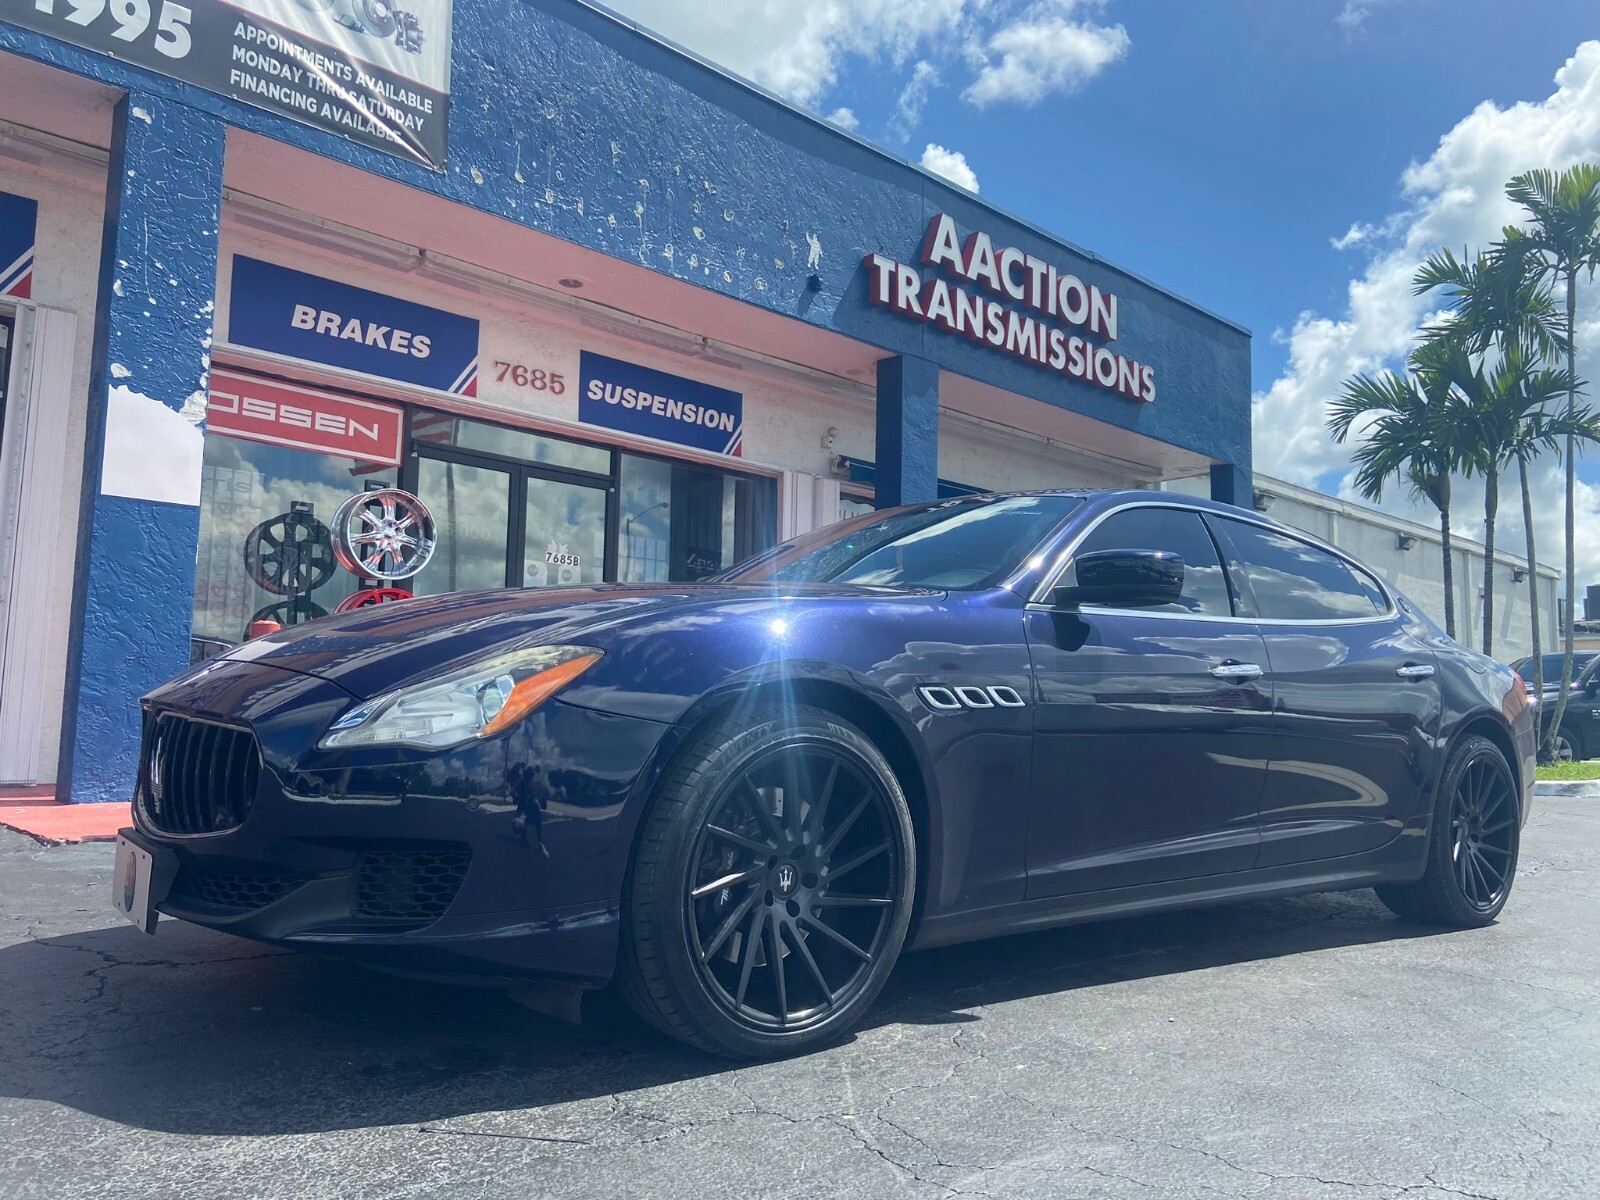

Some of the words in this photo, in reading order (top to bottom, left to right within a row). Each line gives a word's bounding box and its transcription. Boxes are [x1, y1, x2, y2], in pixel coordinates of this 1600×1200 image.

[35, 0, 192, 59] 95
[232, 45, 304, 83] MONDAY
[306, 72, 347, 100] THRU
[349, 91, 425, 132] SATURDAY
[234, 22, 352, 81] APPOINTMENTS
[356, 73, 433, 114] AVAILABLE
[230, 69, 318, 113] FINANCING
[320, 105, 402, 143] AVAILABLE
[922, 212, 1118, 343] AACTION
[291, 303, 432, 360] BRAKES
[865, 253, 1156, 403] TRANSMISSIONS
[494, 361, 566, 396] 7685
[586, 378, 736, 433] SUSPENSION
[546, 552, 579, 566] 7685B
